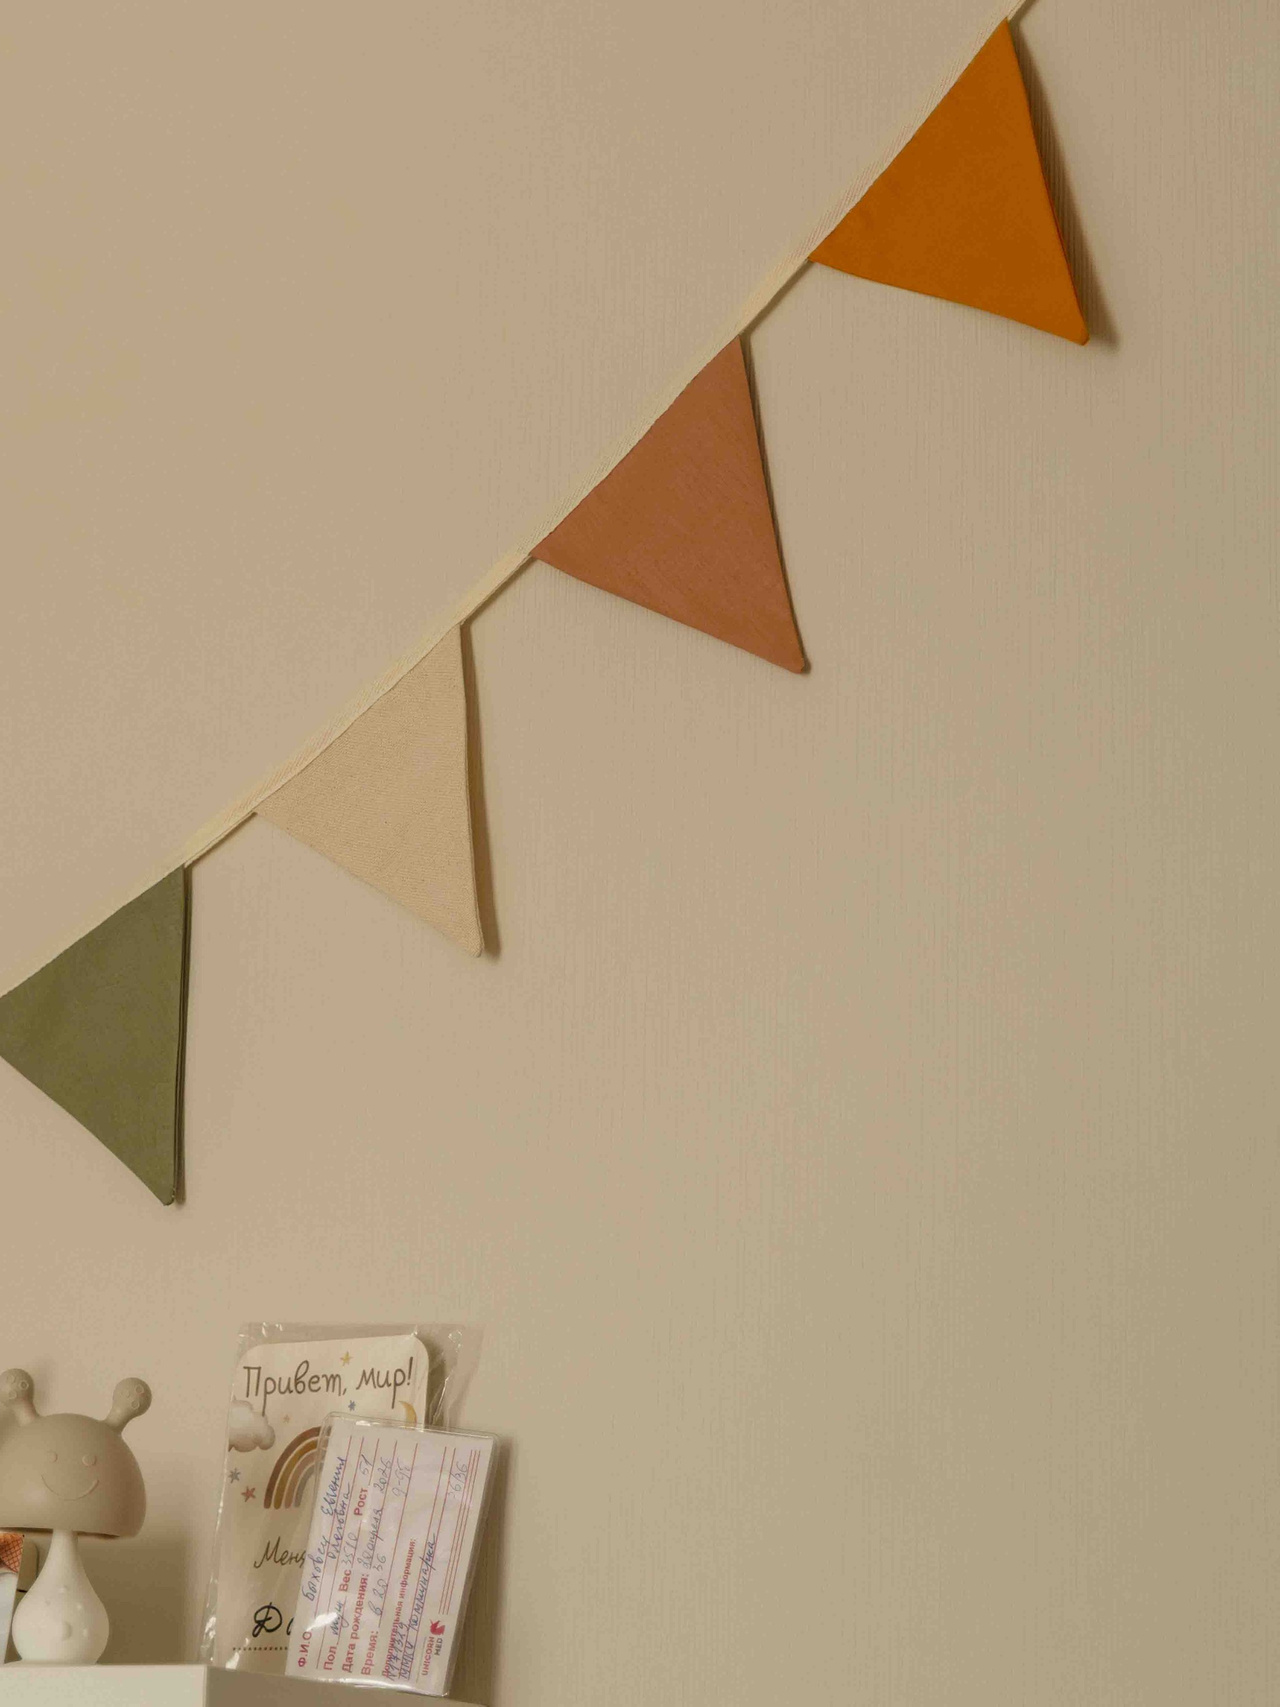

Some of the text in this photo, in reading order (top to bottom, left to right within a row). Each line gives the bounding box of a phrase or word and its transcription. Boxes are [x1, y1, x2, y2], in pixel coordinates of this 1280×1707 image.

[243, 1357, 414, 1417] Привет, мир!
[324, 1646, 337, 1670] Пол
[338, 1569, 351, 1592] Вес
[354, 1488, 369, 1516] Рост
[399, 1539, 416, 1599] информация:
[342, 1644, 355, 1673] Дата
[350, 1574, 368, 1640] рождения:
[361, 1631, 378, 1675] Время:
[434, 1638, 442, 1655] MED
[422, 1636, 434, 1675] UNICORN
